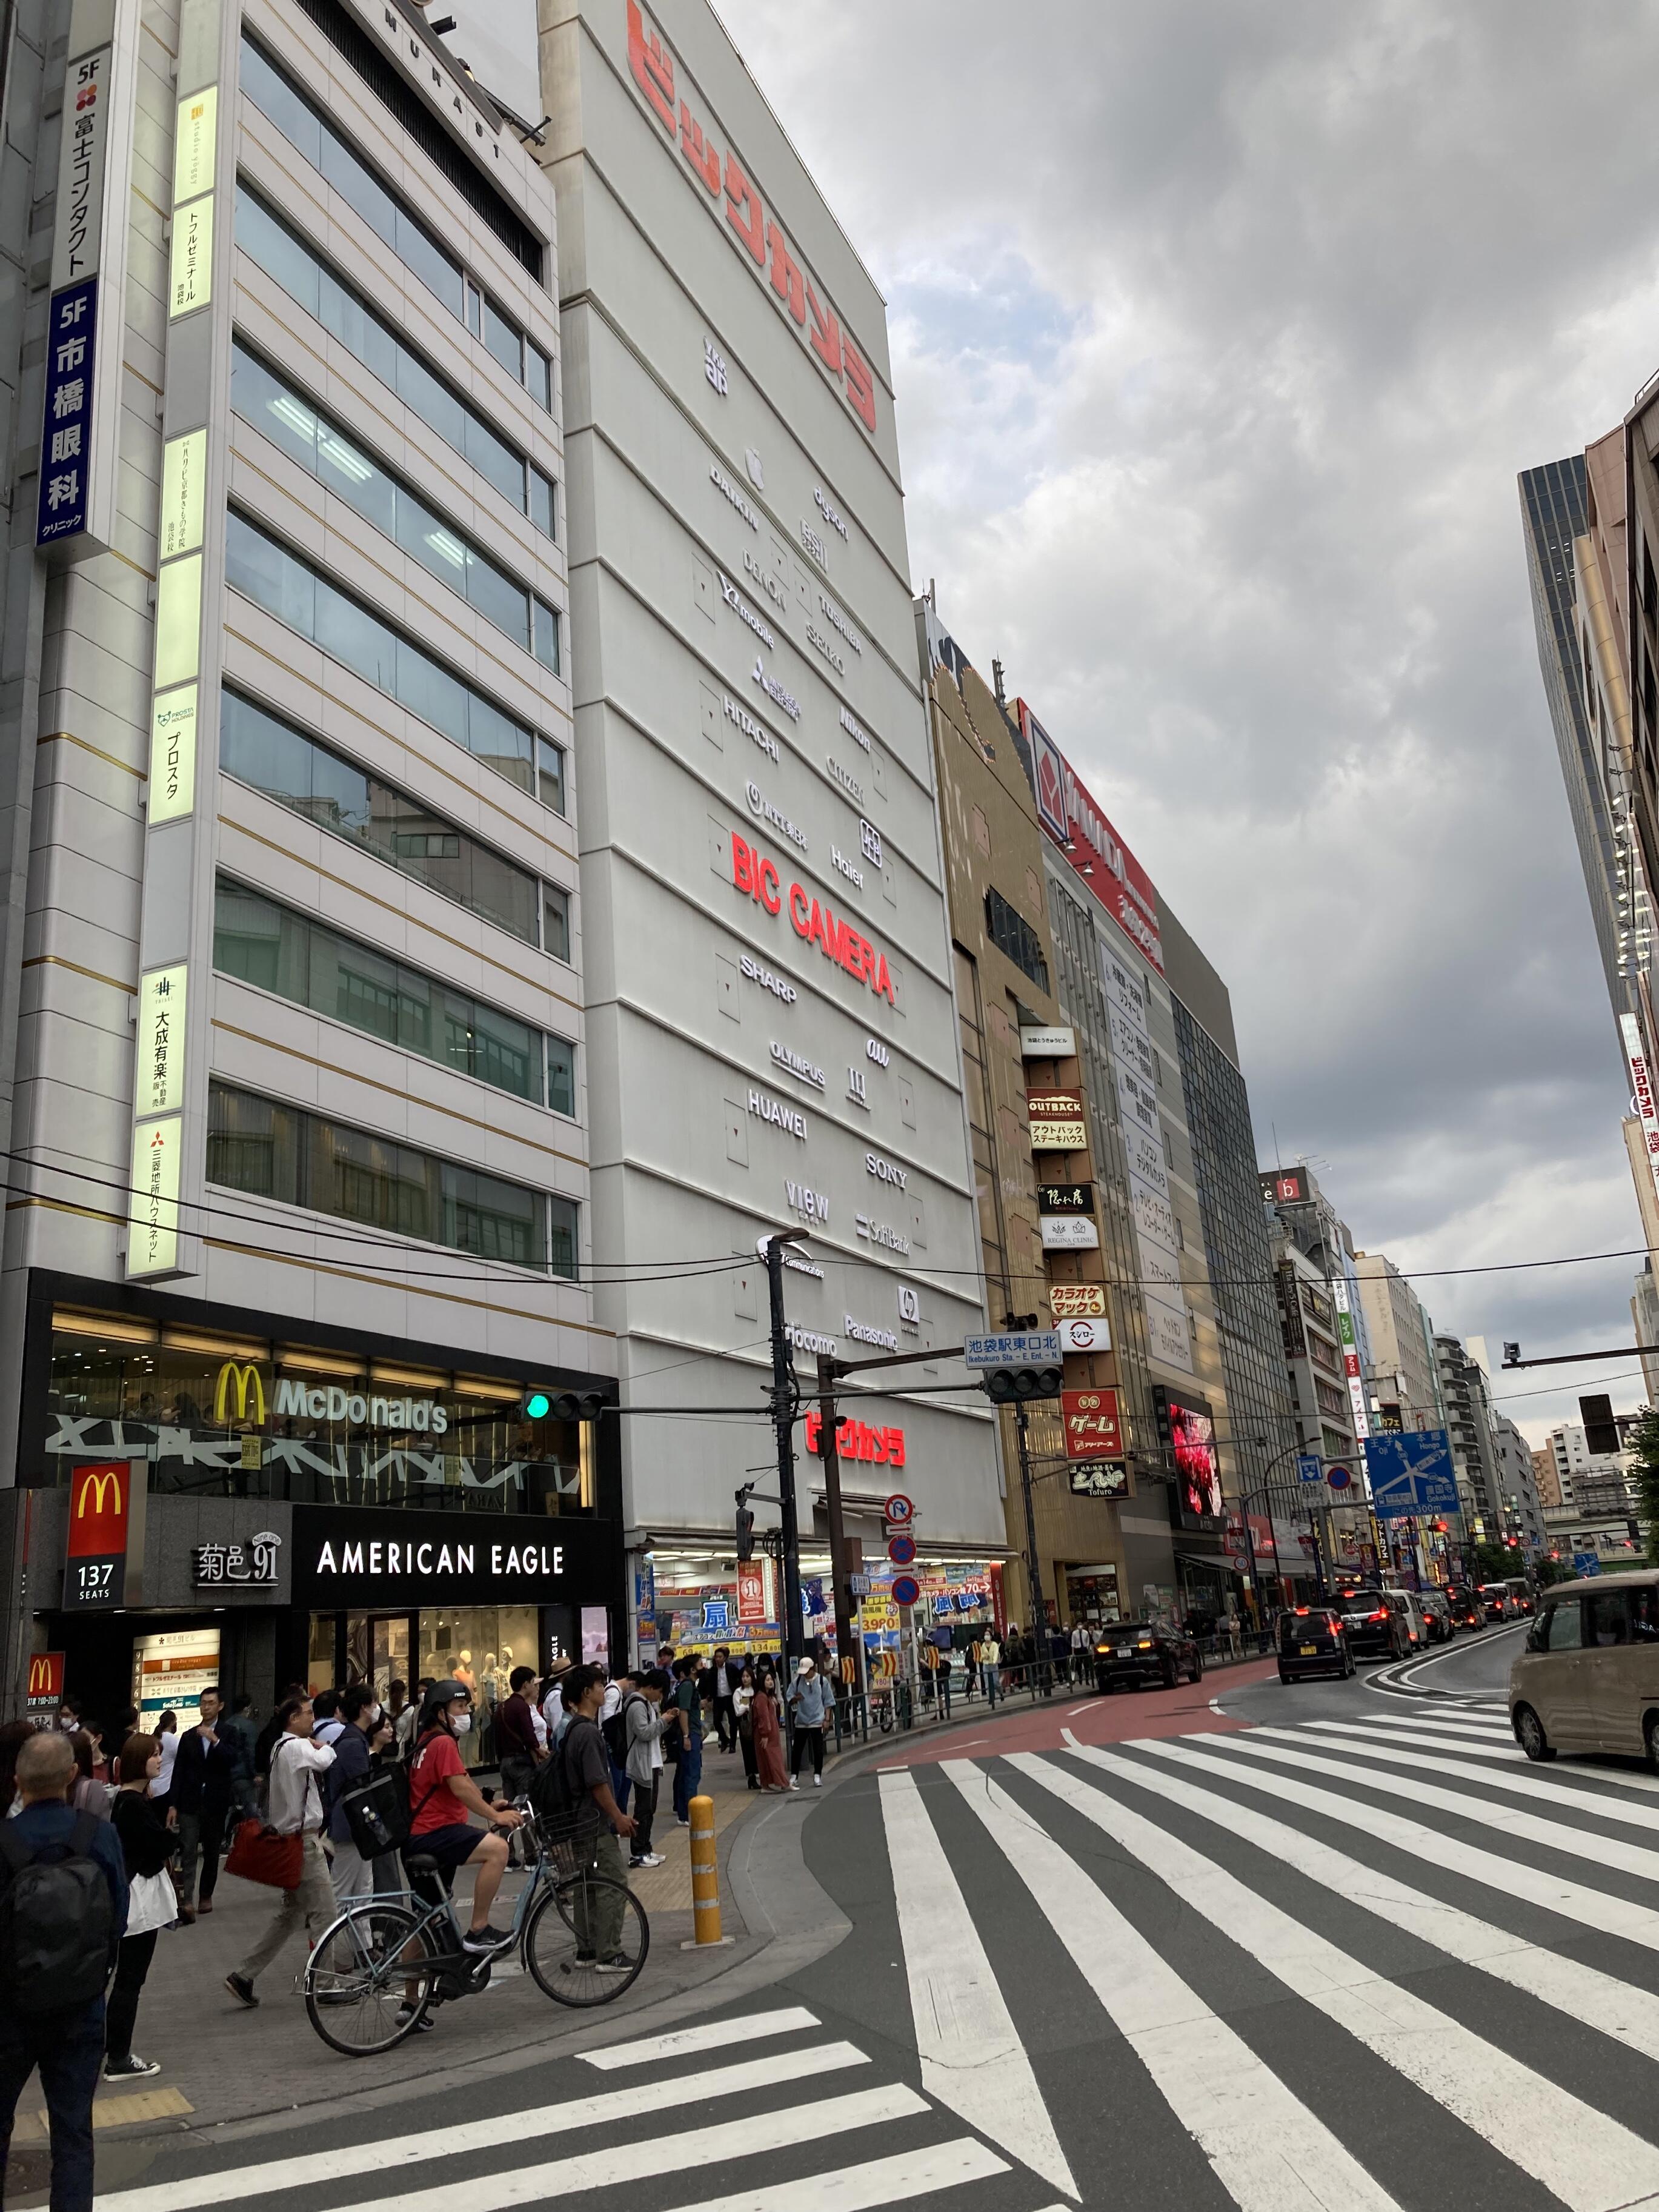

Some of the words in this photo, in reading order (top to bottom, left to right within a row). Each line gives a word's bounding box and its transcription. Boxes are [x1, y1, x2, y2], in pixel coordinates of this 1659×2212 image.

[78, 59, 99, 85] 5F
[69, 114, 96, 277] 富士コンタクト
[185, 213, 198, 302] トフルゼミナール
[59, 296, 87, 329] 5F
[48, 336, 86, 511] 市橋眼科
[710, 463, 758, 532] DAIKIN
[813, 486, 848, 543] dyson
[42, 514, 81, 536] クリニック
[743, 548, 786, 612] DENON
[819, 594, 862, 656] TOSHIBA
[806, 622, 845, 676] SEIKO
[723, 694, 779, 763] HITACHI
[839, 706, 870, 753] Nikon
[167, 731, 181, 800] プロスタ
[826, 756, 865, 806] CITIZEN
[830, 843, 863, 889] Haier
[731, 830, 782, 916] BIC
[789, 882, 896, 1006] CAMERA
[739, 954, 797, 1004] SHARP
[154, 1012, 170, 1080] 大成有楽
[866, 1039, 890, 1068] au
[770, 1041, 826, 1086] OLYMPUS
[747, 1089, 808, 1140] HUAWEI
[1029, 1102, 1082, 1112] OUTBACK
[1032, 1126, 1082, 1135] アウトバック
[1033, 1135, 1085, 1144] ステーキハウス
[865, 1153, 908, 1191] SONY
[1135, 1152, 1166, 1190] デジタルカメラ
[149, 1149, 161, 1263] 三菱地所ハウスネット
[1047, 1188, 1084, 1206] 隠れ房
[869, 1220, 910, 1255] SoftBank
[1051, 1287, 1100, 1301] カラオケ
[1054, 1301, 1088, 1315] マック
[785, 1325, 838, 1357] docomo
[843, 1314, 898, 1351] Panasonic
[968, 1335, 1057, 1353] 池袋駅東口北
[1069, 1330, 1096, 1340] スシロー
[1341, 1318, 1351, 1339] レイク
[968, 1355, 1000, 1363] Ikebukuro
[272, 1379, 448, 1434] McDonald's
[804, 1410, 906, 1467] ビクカメラ
[1068, 1414, 1115, 1435] ゲーム
[1415, 1431, 1441, 1443] 本郷
[1370, 1436, 1394, 1449] 王子
[1419, 1442, 1440, 1450] Hongo
[1394, 1504, 1441, 1515] この先300m
[1426, 1493, 1456, 1504] Gokokuji
[253, 1533, 268, 1545] Nine
[268, 1533, 280, 1545] one
[317, 1541, 476, 1575] AMERICAN
[491, 1545, 564, 1575] EAGLE
[1237, 1559, 1246, 1568] 50
[78, 1564, 114, 1587] 137
[79, 1589, 110, 1600] SEATS
